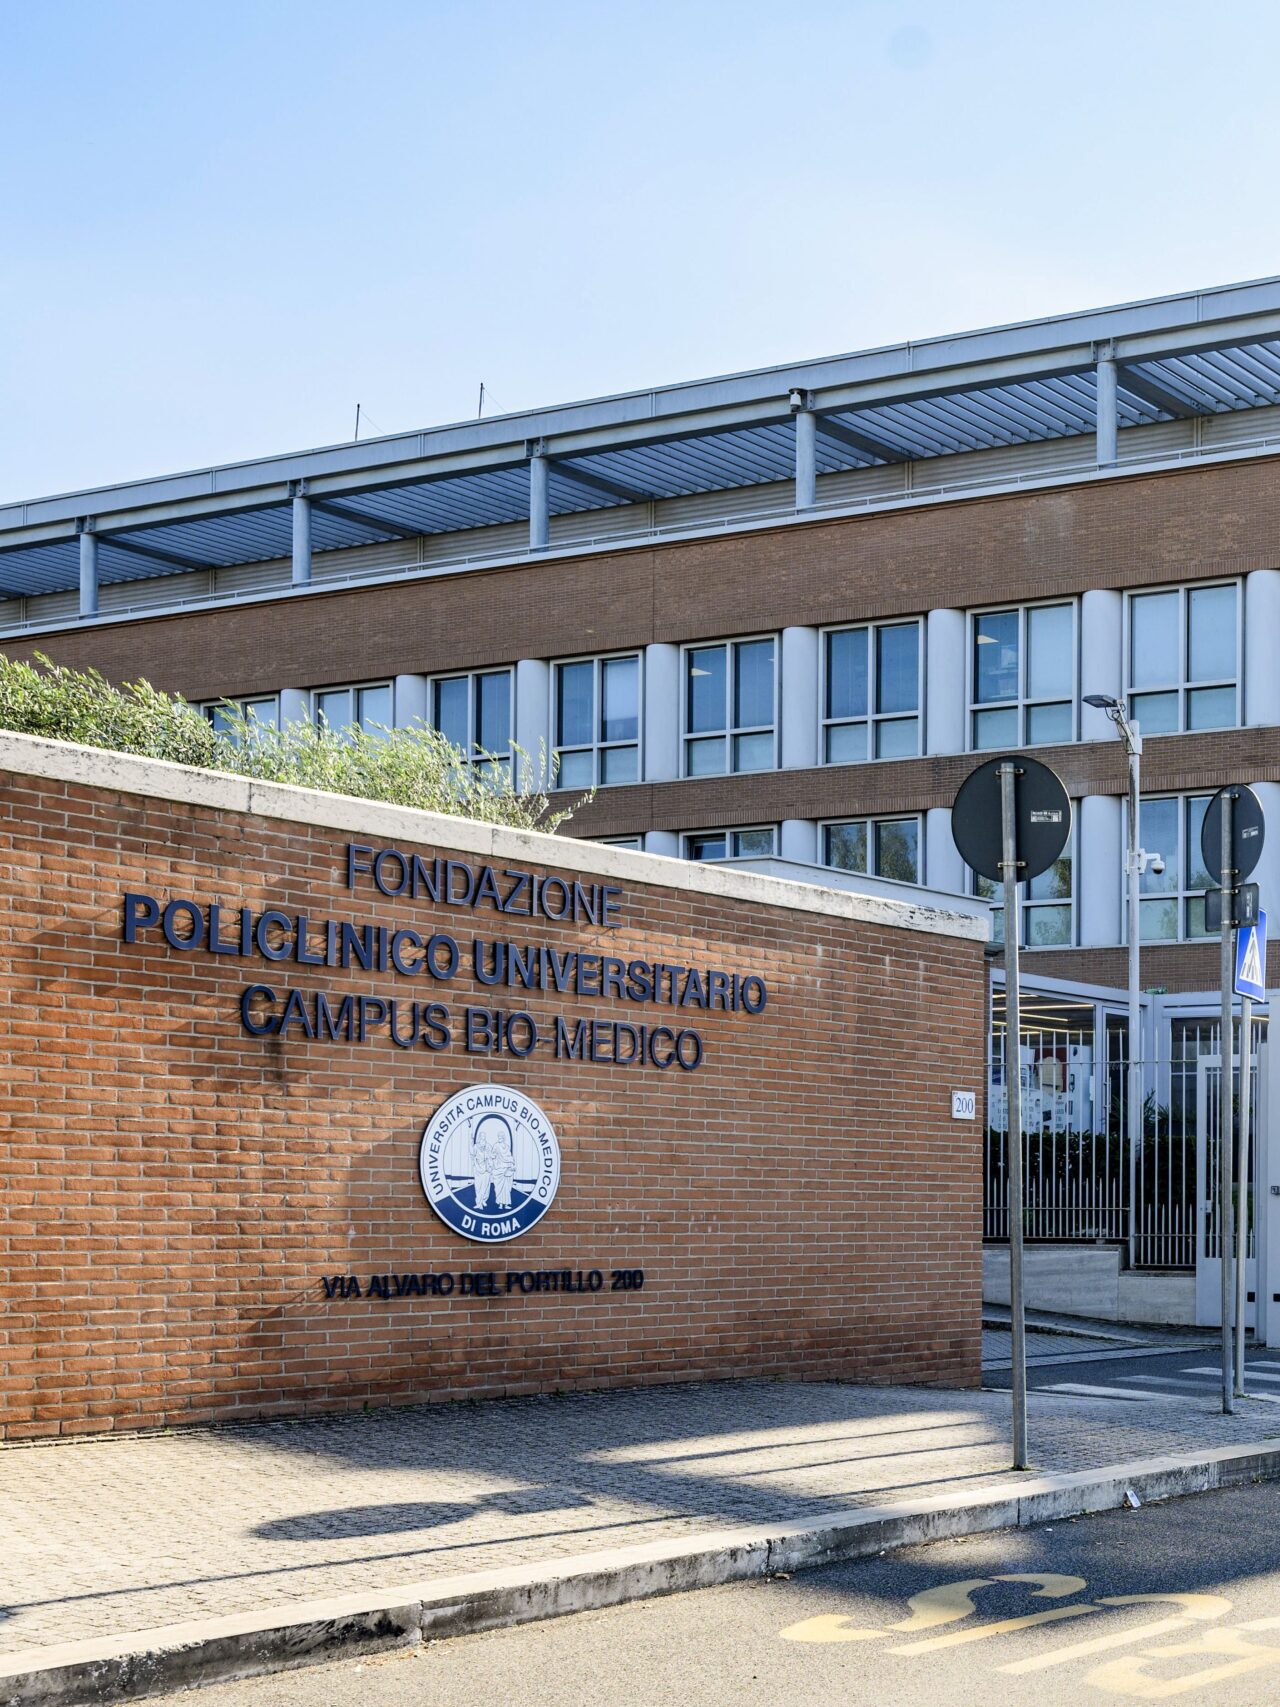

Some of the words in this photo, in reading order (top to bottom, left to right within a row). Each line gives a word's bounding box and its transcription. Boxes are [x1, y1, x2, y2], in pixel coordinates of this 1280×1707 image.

[347, 844, 623, 928] FONDAZIONE
[124, 893, 460, 980] POLICLINICO
[473, 939, 768, 1014] UNIVERSITARIO
[241, 984, 453, 1050] CAMPUS
[466, 1007, 703, 1070] BIO-MEDICO
[466, 1094, 519, 1114] CAMPUS
[520, 1106, 553, 1199] BIO-MEDICO
[955, 1097, 974, 1114] 200
[461, 1215, 477, 1232] DI
[481, 1217, 521, 1236] ROMA
[322, 1276, 362, 1298] VIA
[366, 1272, 454, 1298] ALVARO
[460, 1272, 500, 1295] DEL
[506, 1269, 604, 1293] PORTILLO
[611, 1269, 645, 1290] 200
